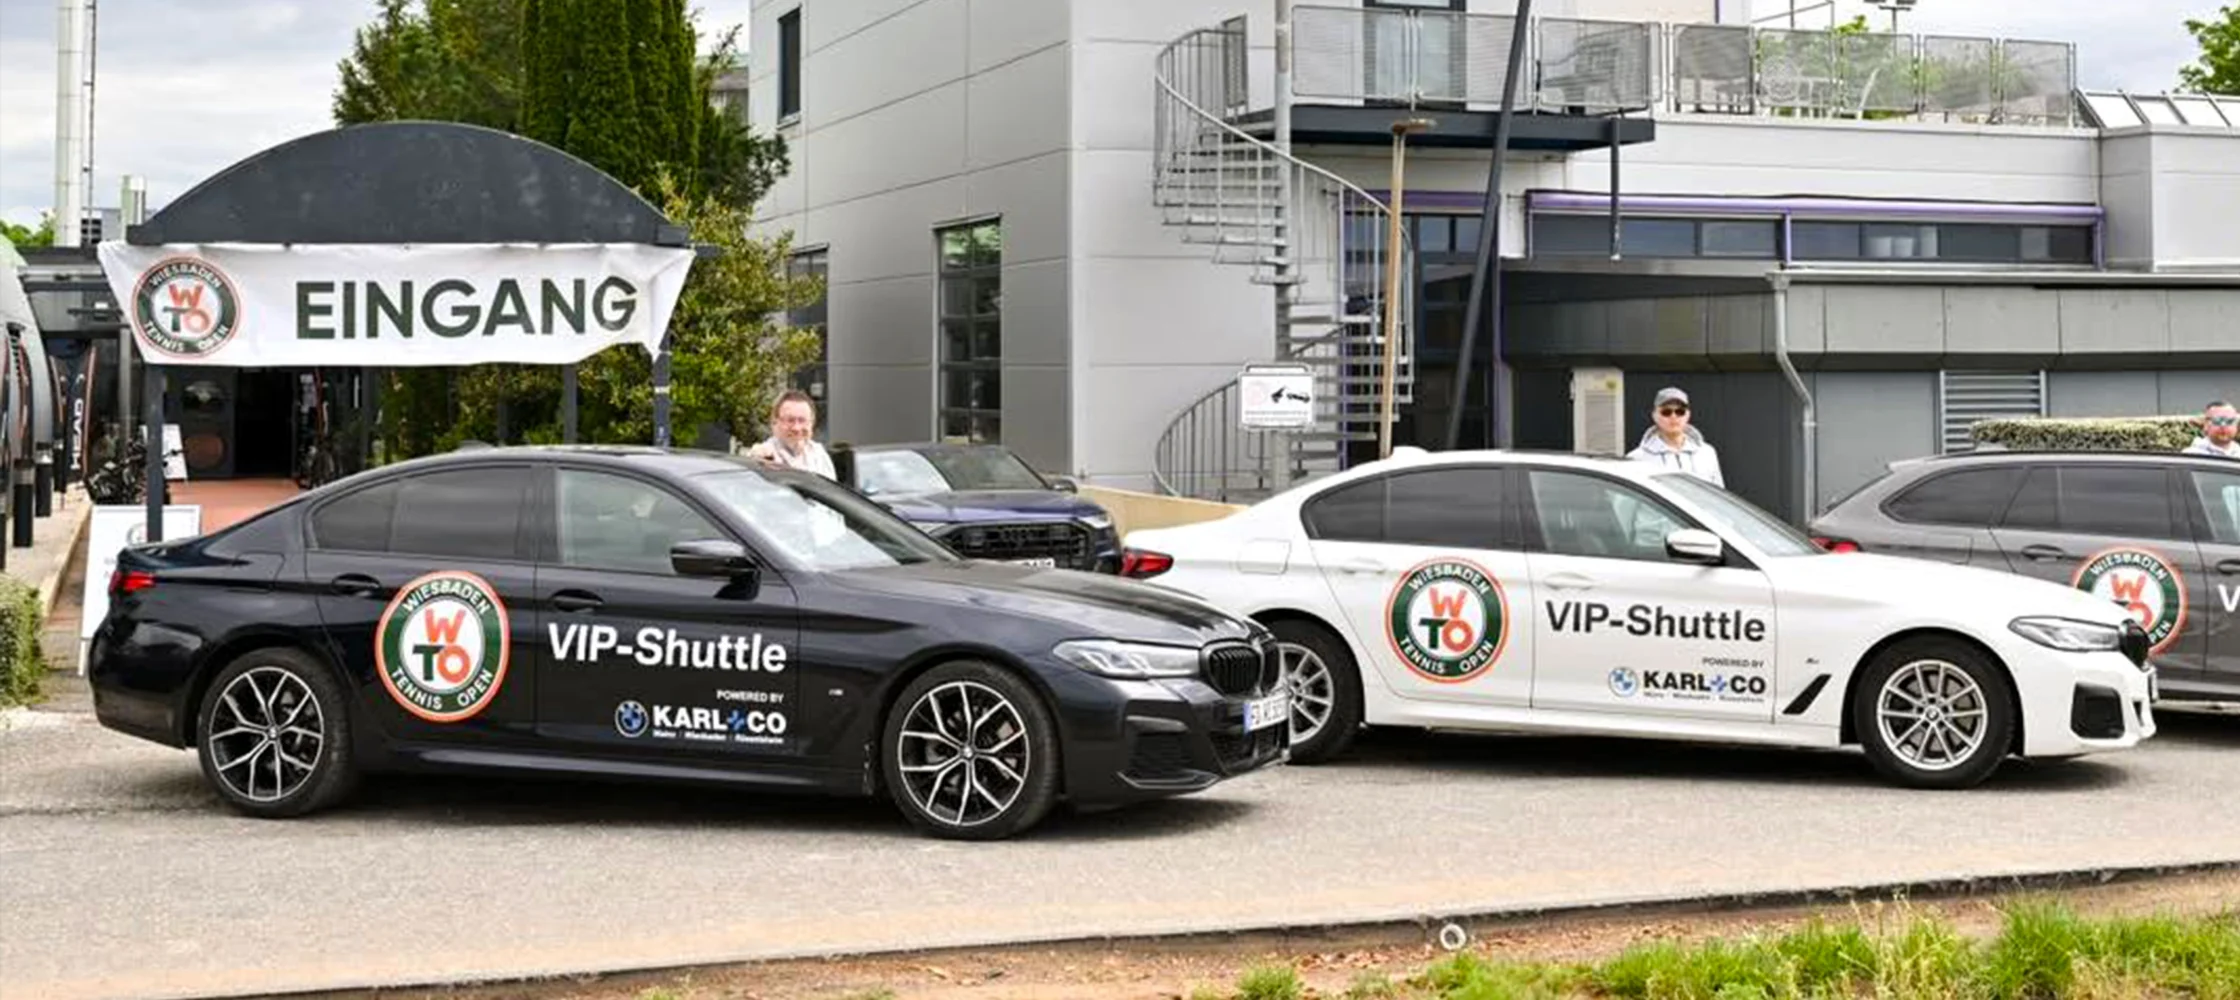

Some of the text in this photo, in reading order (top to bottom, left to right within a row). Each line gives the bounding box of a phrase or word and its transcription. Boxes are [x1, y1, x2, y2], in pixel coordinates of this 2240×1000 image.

[149, 263, 223, 288] WIESBADEN
[296, 275, 638, 339] EINGANG
[143, 320, 230, 352] TENNIS OPEN
[1407, 563, 1491, 595] WIESBADEN
[2089, 553, 2169, 581] WIESBADEN
[402, 580, 491, 615] WIESBADEN
[1546, 600, 1766, 641] VIP-Shuttle
[2148, 620, 2172, 644] PEN
[548, 623, 787, 673] VIP-Shuttle
[1400, 635, 1494, 674] TENNIS OPEN
[1702, 656, 1750, 667] POWERED
[391, 666, 494, 710] TENNIS OPEN
[716, 689, 784, 703] POWERED BY
